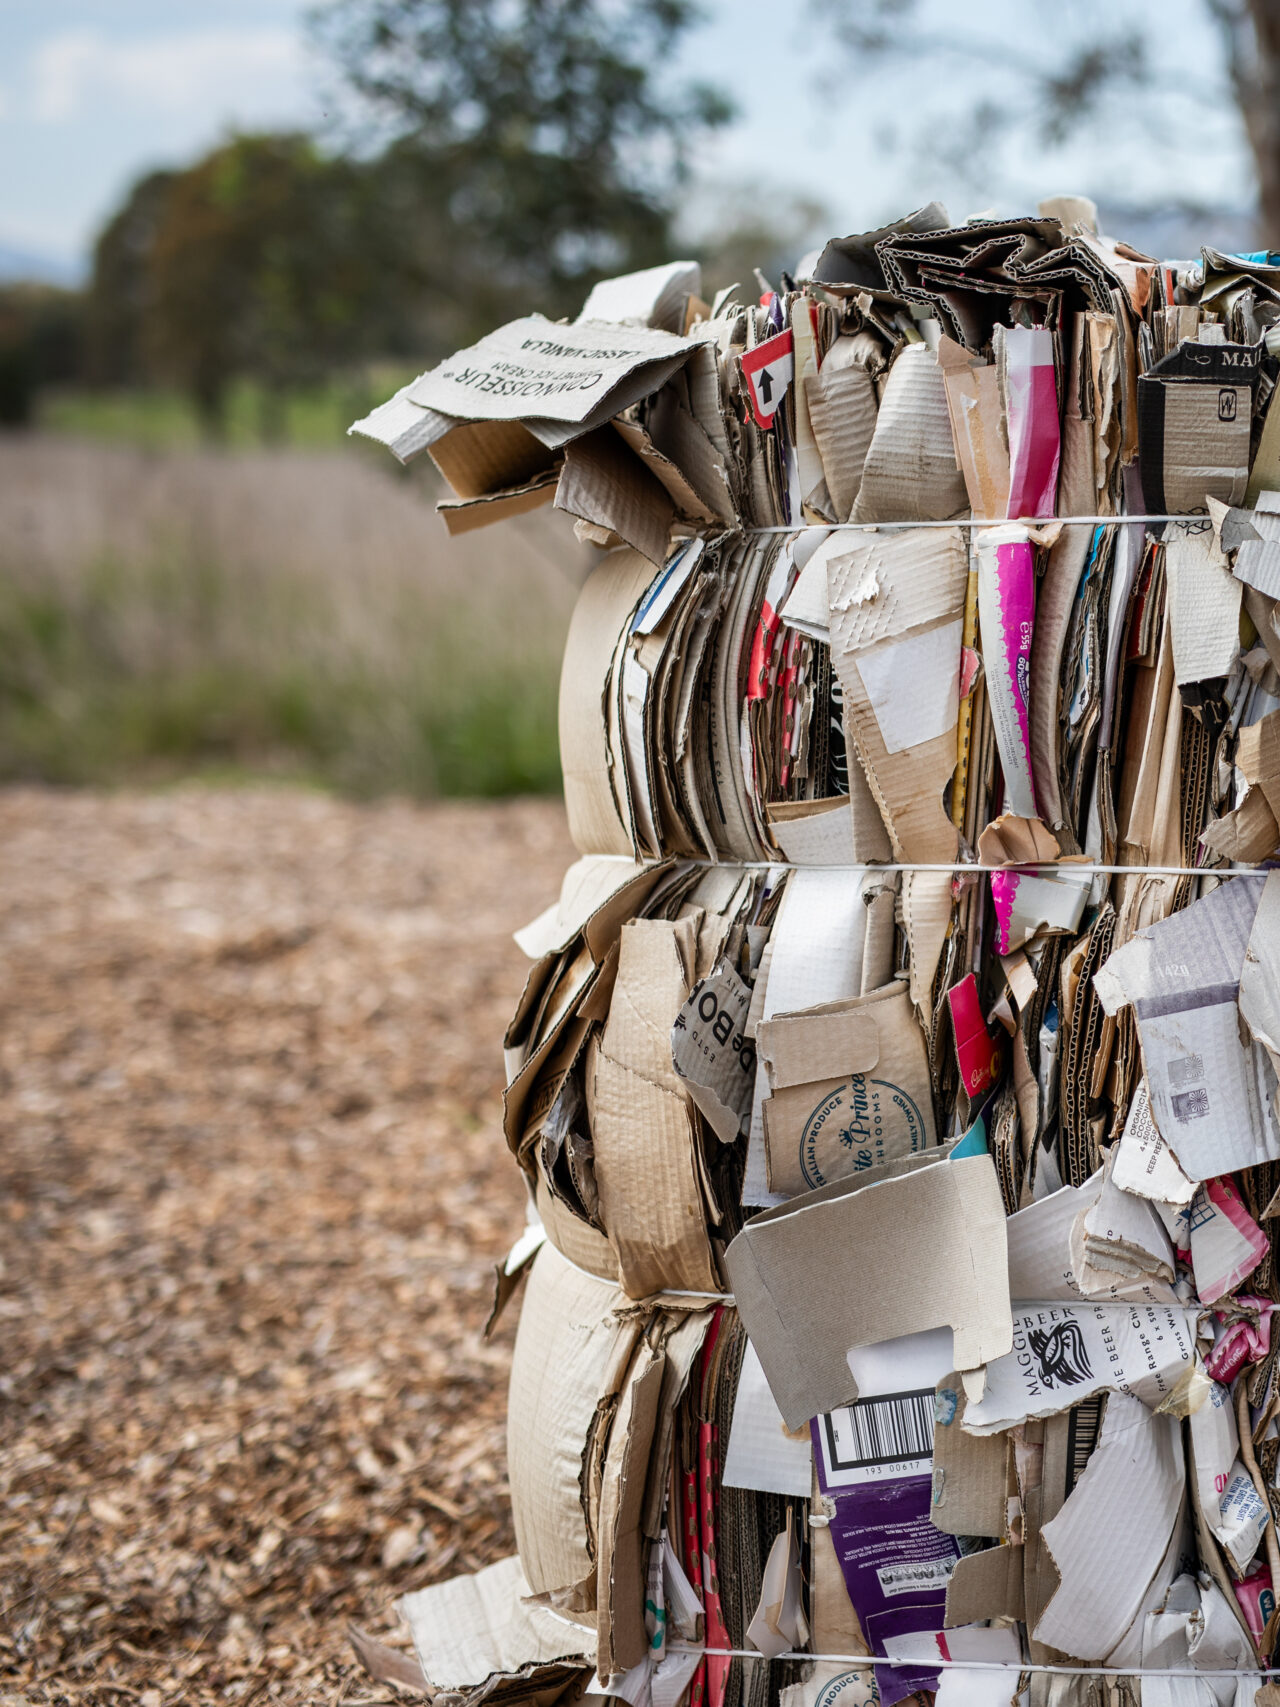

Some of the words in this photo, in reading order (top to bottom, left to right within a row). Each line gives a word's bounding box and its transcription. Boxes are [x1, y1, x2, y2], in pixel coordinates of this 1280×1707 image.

[455, 367, 603, 396] CONNOISSEUR
[492, 361, 535, 378] CREAM
[1156, 964, 1189, 978] 1420
[692, 1031, 716, 1063] ESTD
[808, 1096, 843, 1143] PRODUCE
[849, 1072, 871, 1144] Prince
[892, 1095, 915, 1123] OWNED
[1130, 1098, 1146, 1136] ORGANIC
[909, 1124, 918, 1154] AMILY
[1146, 1155, 1158, 1174] KEEP
[1022, 1307, 1076, 1330] BEER
[1101, 1325, 1119, 1362] BEER
[1140, 1333, 1157, 1370] Range
[1174, 1331, 1189, 1360] Gross
[865, 1466, 882, 1475] 193
[889, 1461, 920, 1473] 00617
